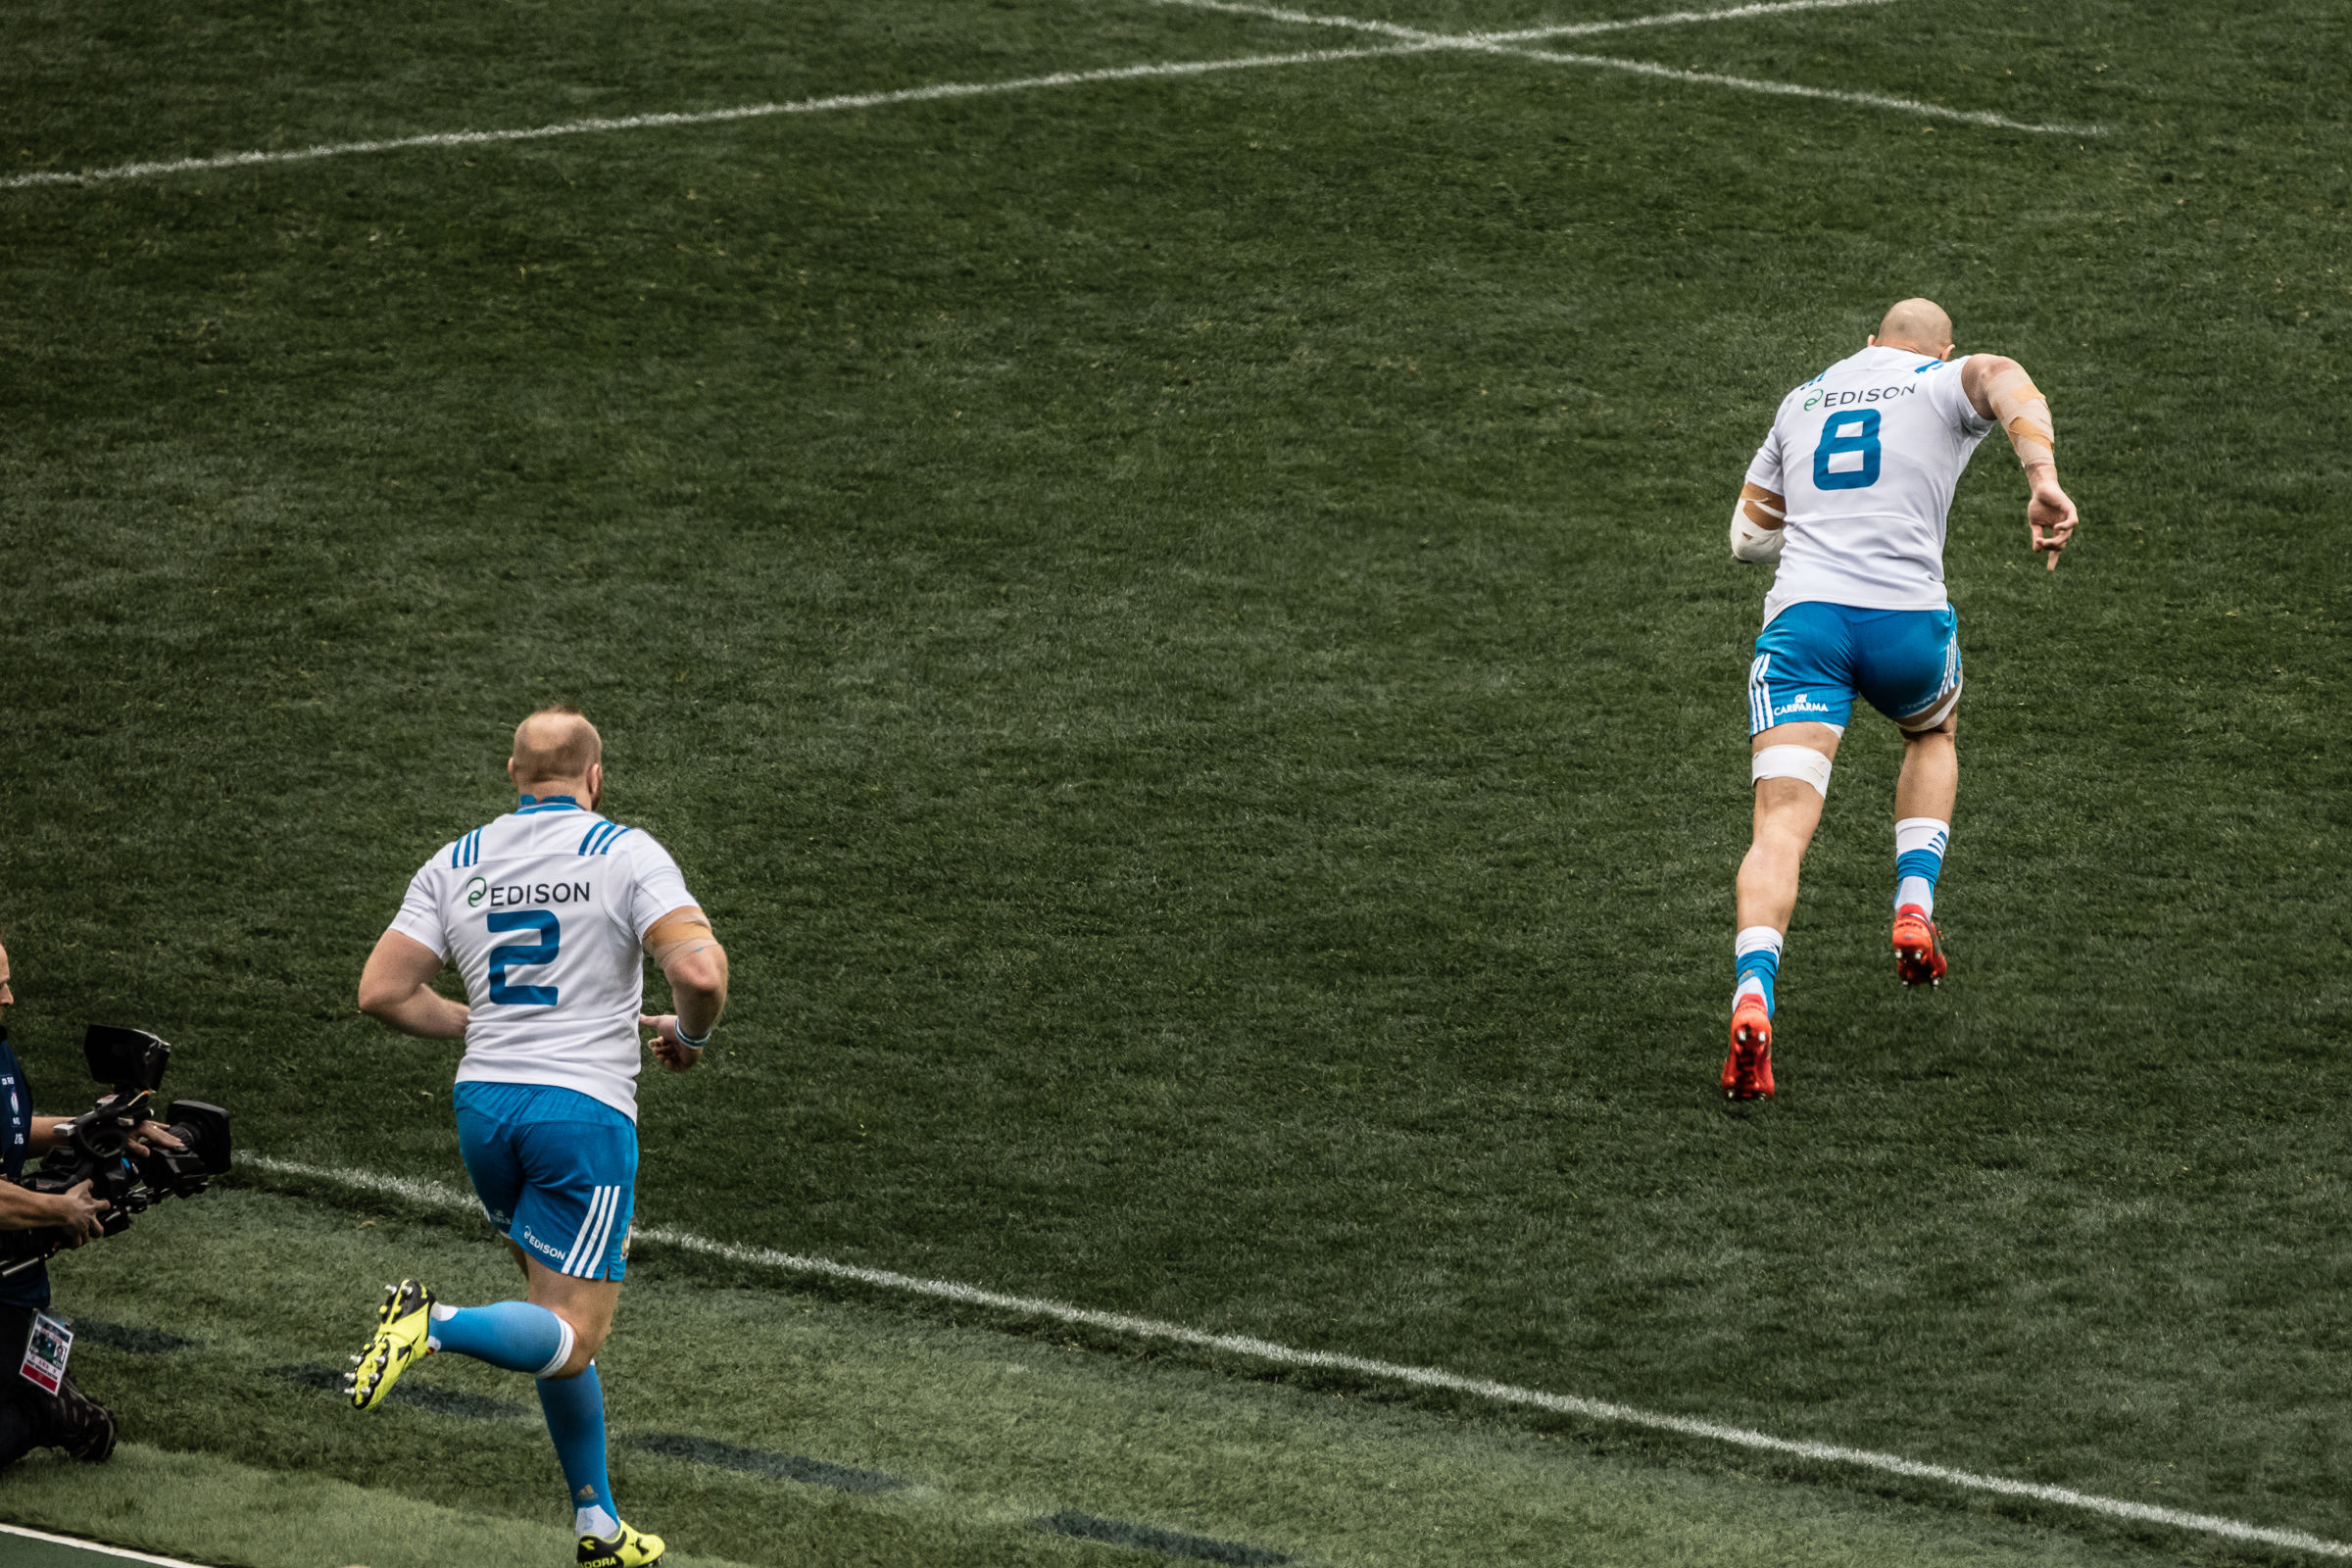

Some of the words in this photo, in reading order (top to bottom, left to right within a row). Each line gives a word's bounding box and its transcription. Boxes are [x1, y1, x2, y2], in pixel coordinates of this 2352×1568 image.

[1824, 383, 1917, 408] EDISON
[1813, 408, 1881, 491] 8
[1774, 703, 1829, 716] CARIPARMA
[490, 882, 590, 906] EDISON
[487, 909, 561, 1006] 2
[529, 1237, 566, 1260] EDISON
